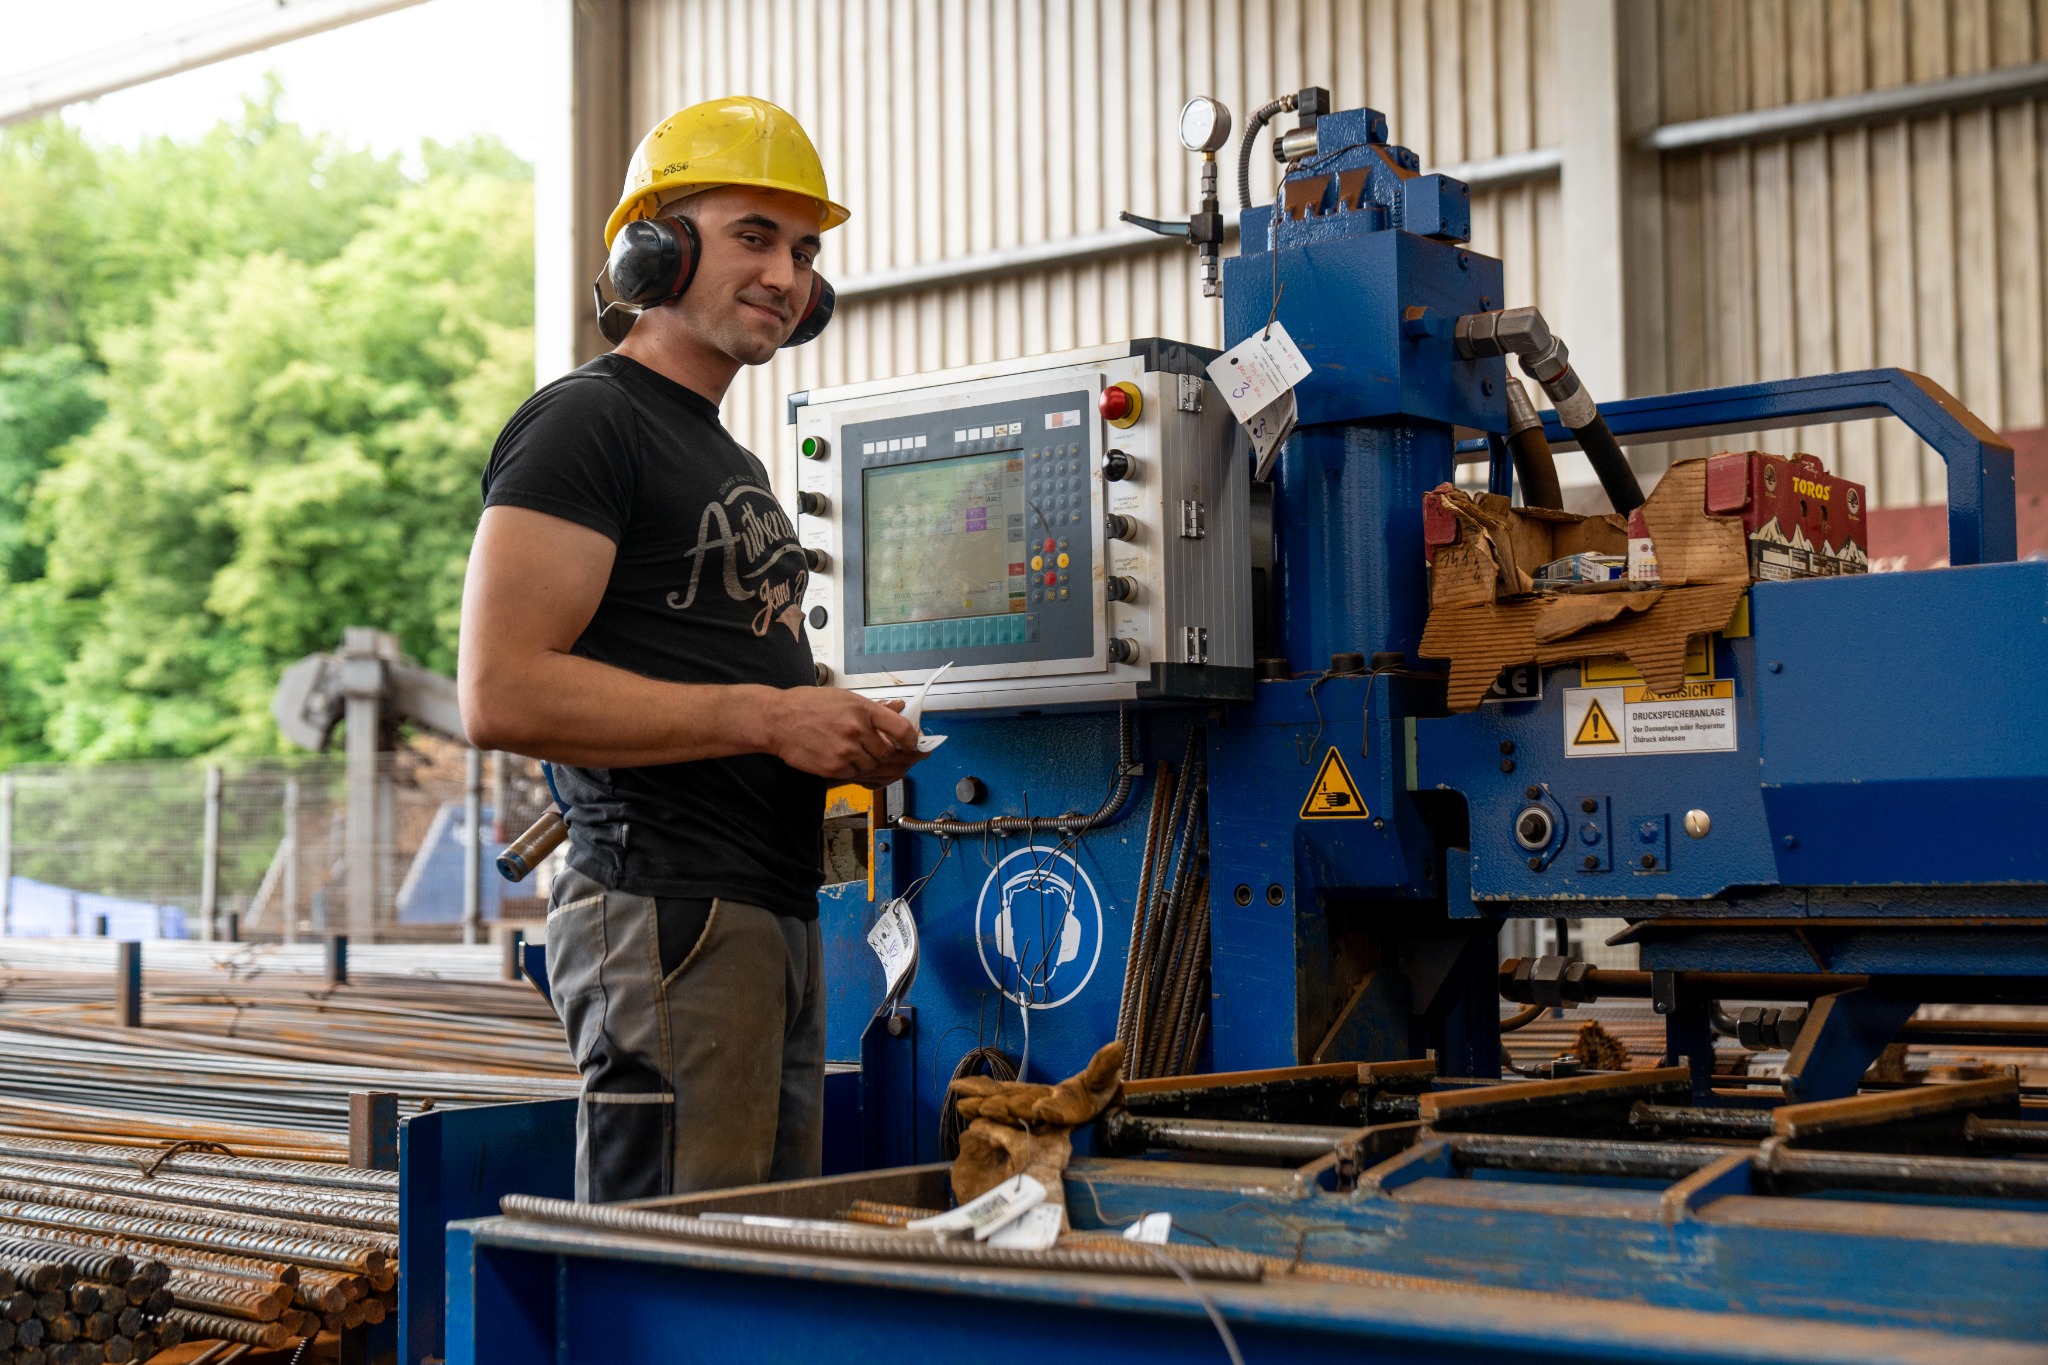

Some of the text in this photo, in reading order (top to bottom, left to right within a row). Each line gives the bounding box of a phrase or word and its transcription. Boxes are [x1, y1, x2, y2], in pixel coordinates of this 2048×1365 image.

[1792, 476, 1831, 501] TOROS
[665, 501, 798, 610] Authenti
[1632, 708, 1726, 721] DRUCKSPEICHERANLAGE
[1644, 724, 1678, 733] Demontage
[1680, 723, 1693, 731] oder
[1695, 722, 1726, 731] Reparatur
[1633, 734, 1657, 743] Öldruck
